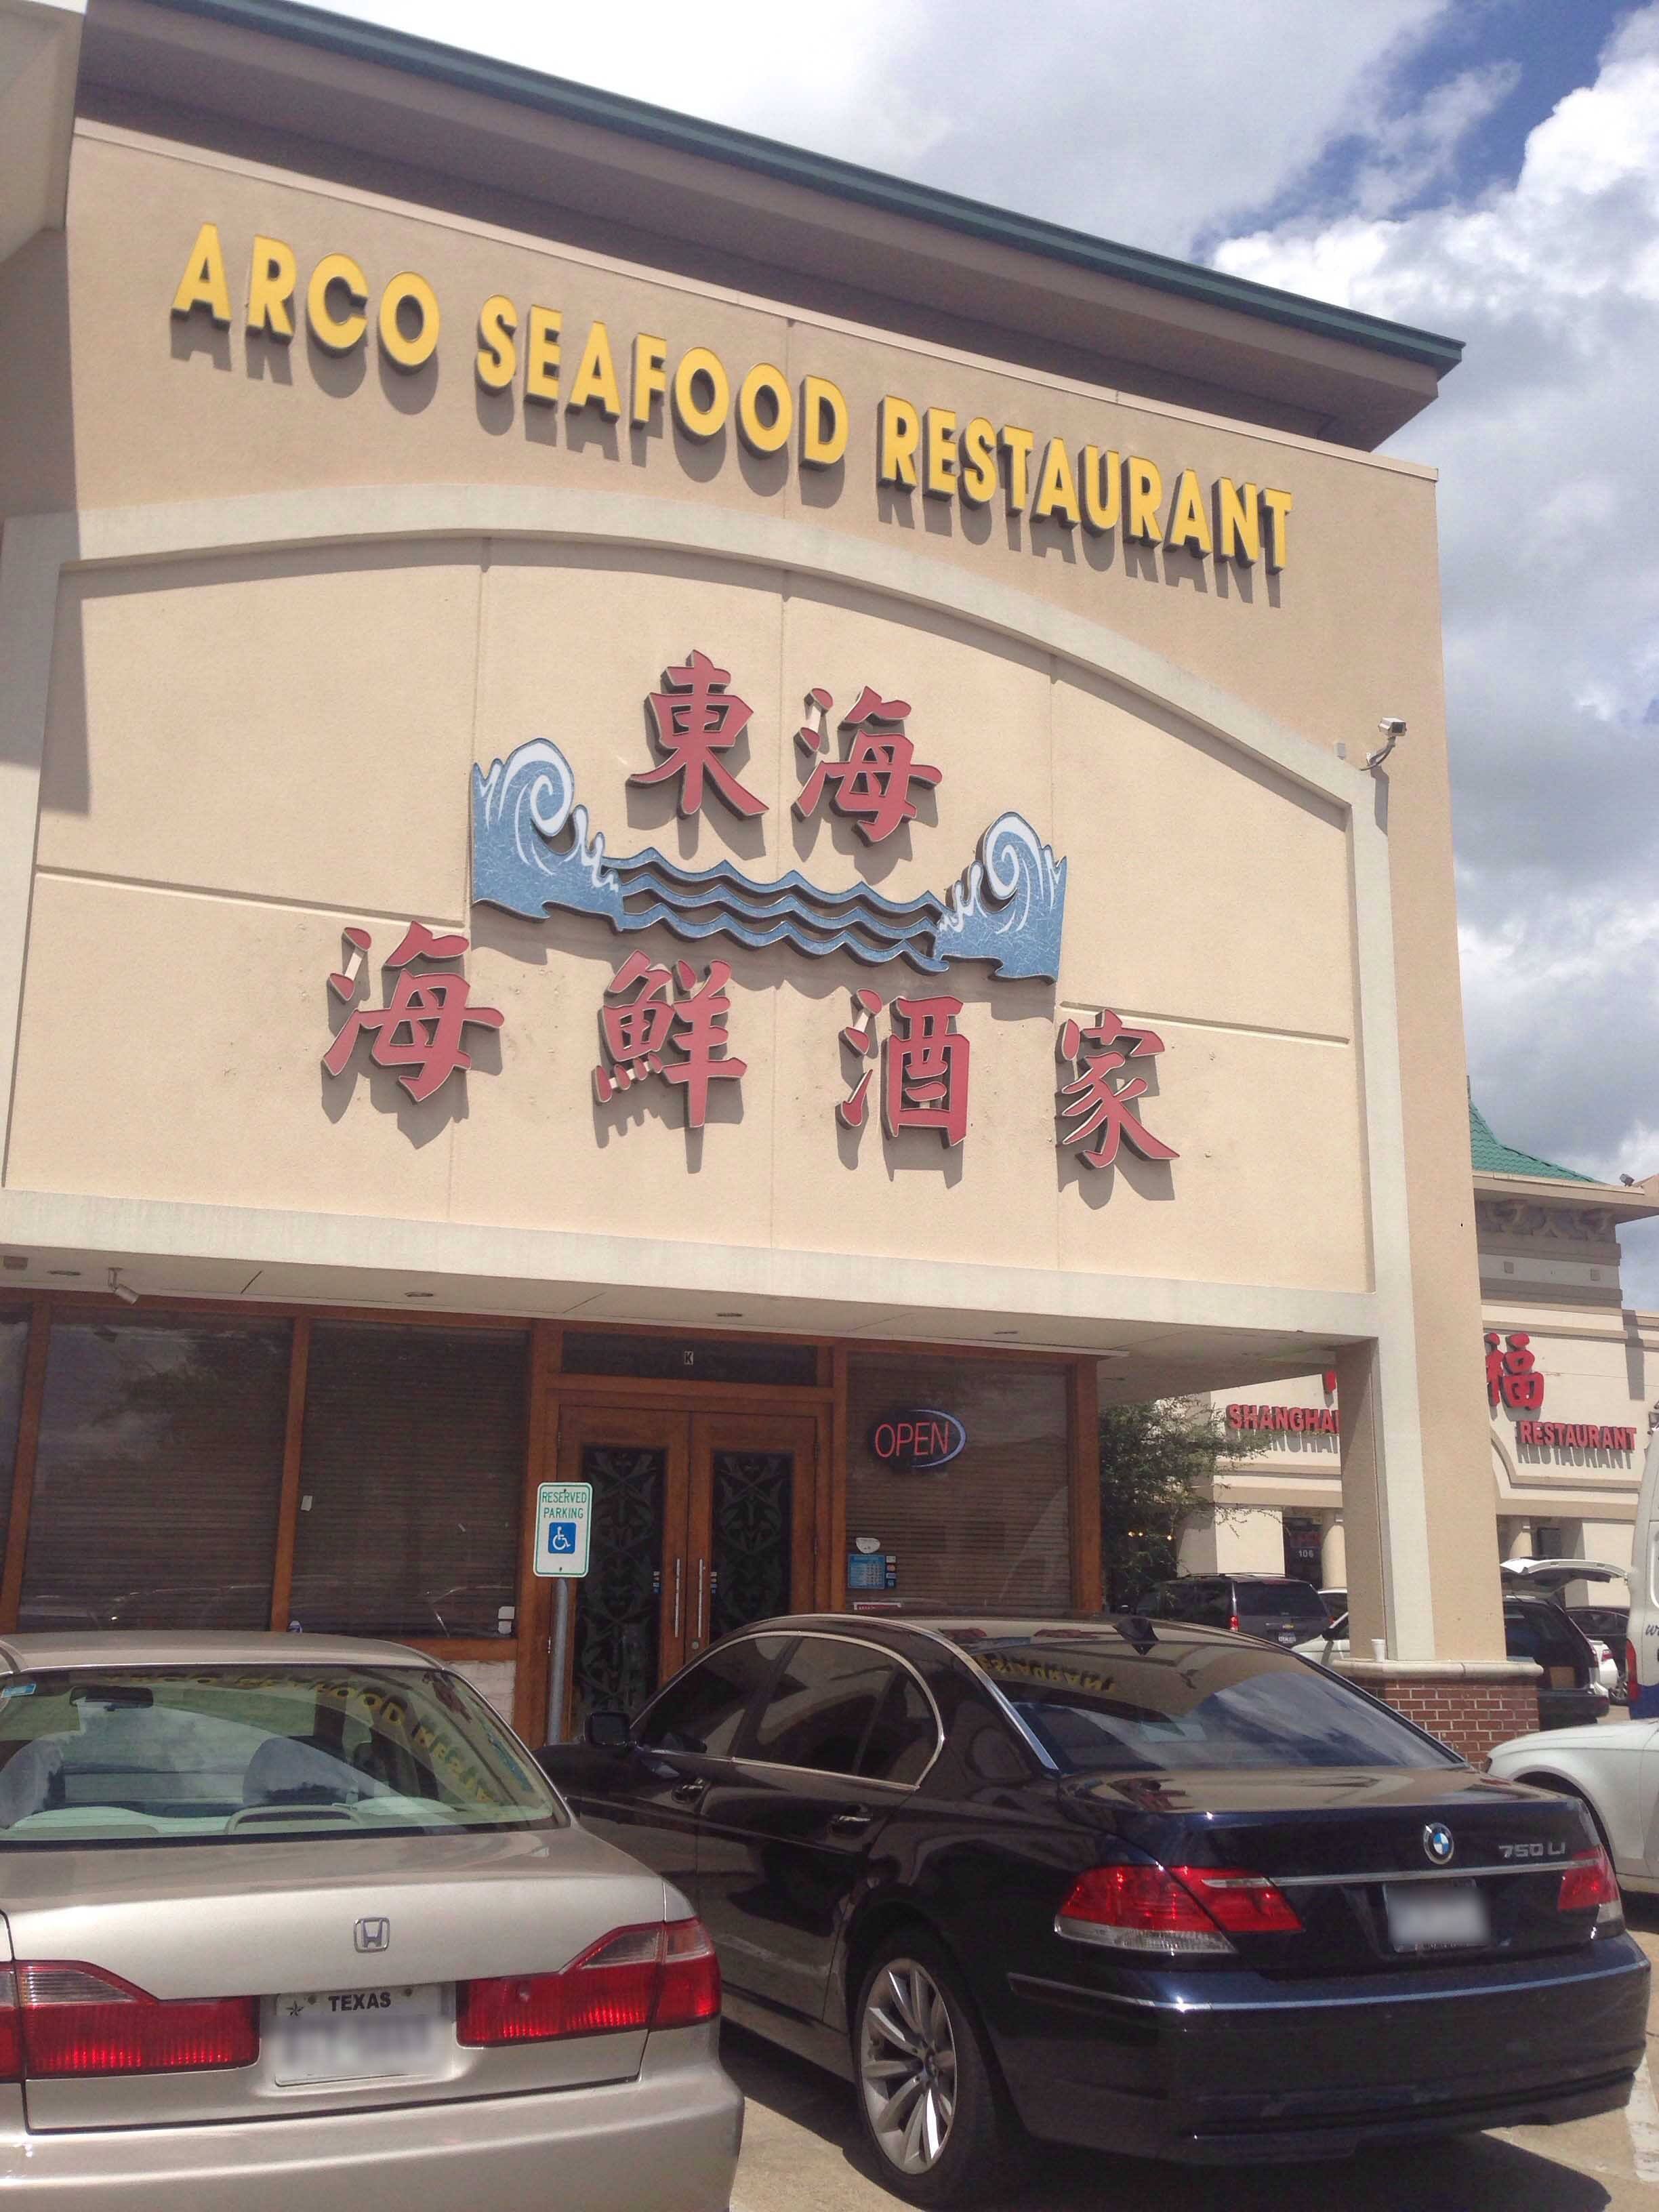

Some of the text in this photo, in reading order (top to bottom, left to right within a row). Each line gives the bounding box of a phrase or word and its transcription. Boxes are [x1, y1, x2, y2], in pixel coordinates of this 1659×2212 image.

[170, 224, 1292, 574] ARCO SEAFOOD RESTAURANT
[628, 649, 943, 846] 東海
[321, 920, 1181, 1170] 海鮮酒家
[875, 1421, 949, 1458] OPEN
[1516, 1420, 1637, 1453] RESTAURANT
[542, 1492, 587, 1503] RESERVED
[544, 1507, 583, 1519] PARKING
[328, 1992, 392, 2011] TEXAS
